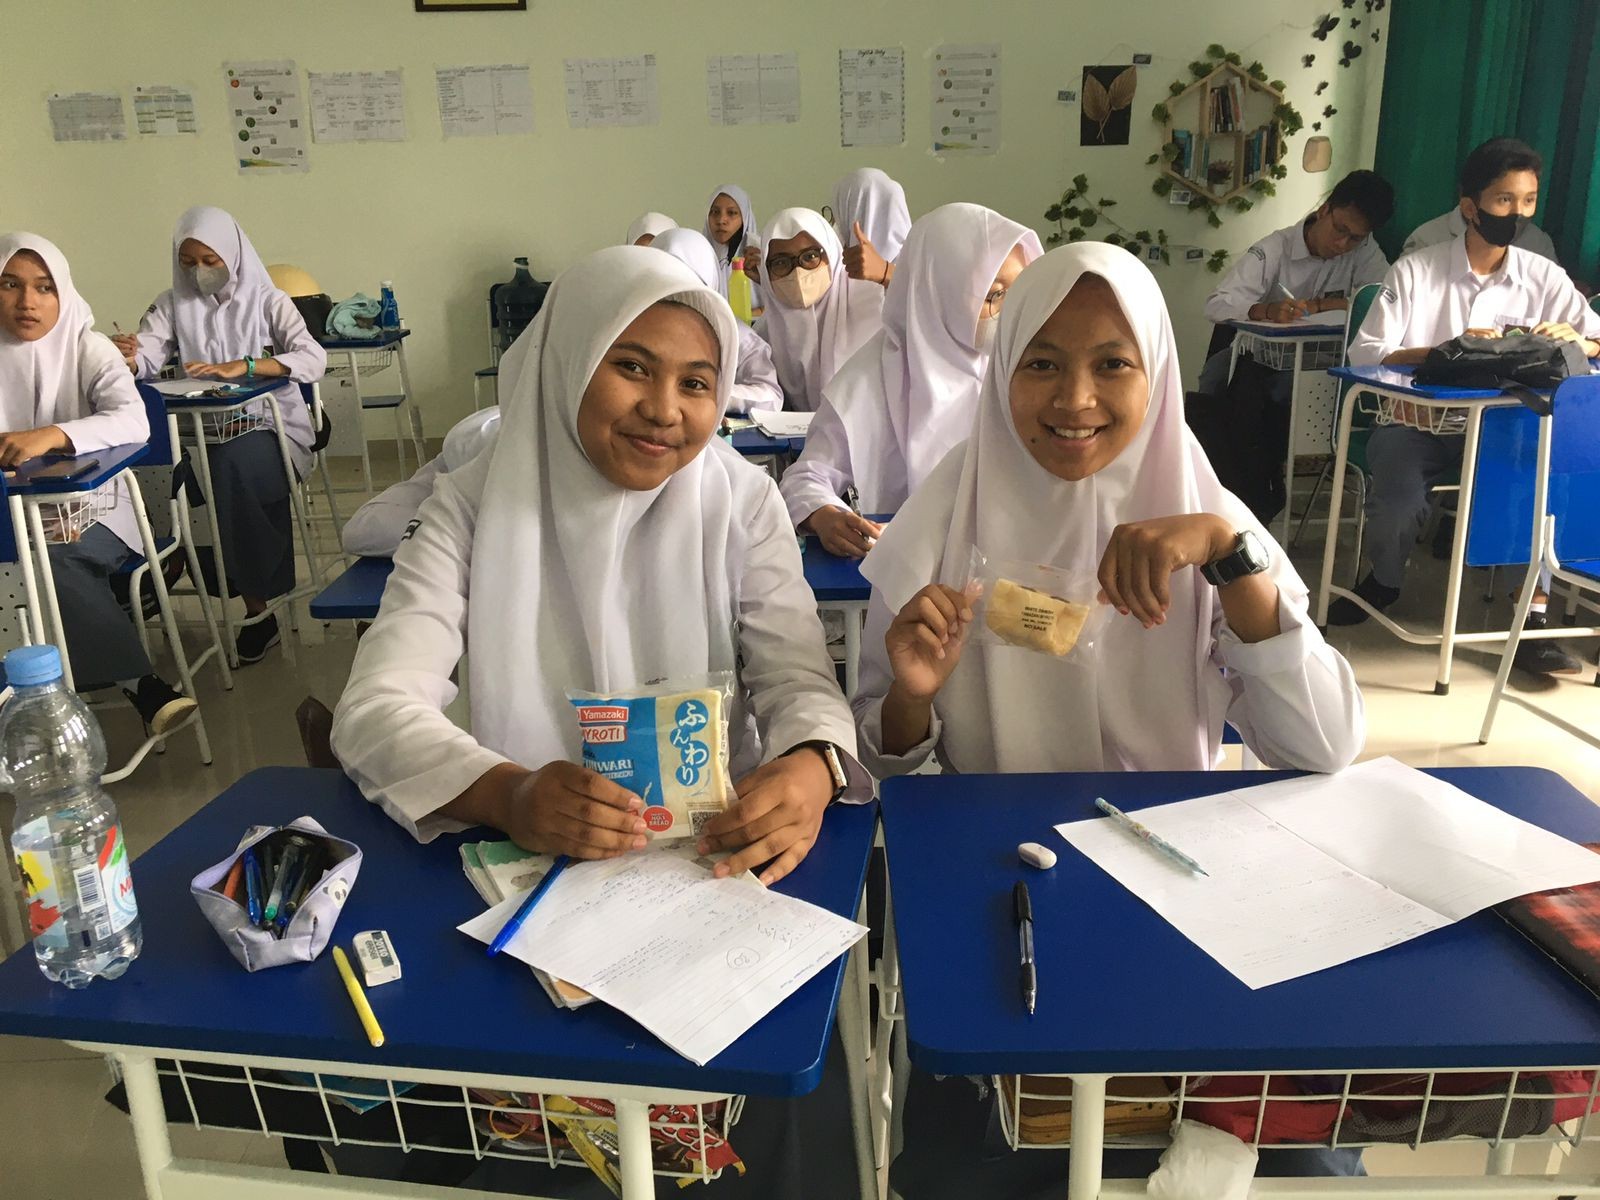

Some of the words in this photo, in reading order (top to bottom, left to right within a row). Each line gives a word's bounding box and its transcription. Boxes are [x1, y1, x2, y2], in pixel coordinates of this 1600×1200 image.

[583, 709, 625, 719] Yamazaki
[584, 727, 620, 741] YROTI
[674, 703, 707, 785] ふんわり
